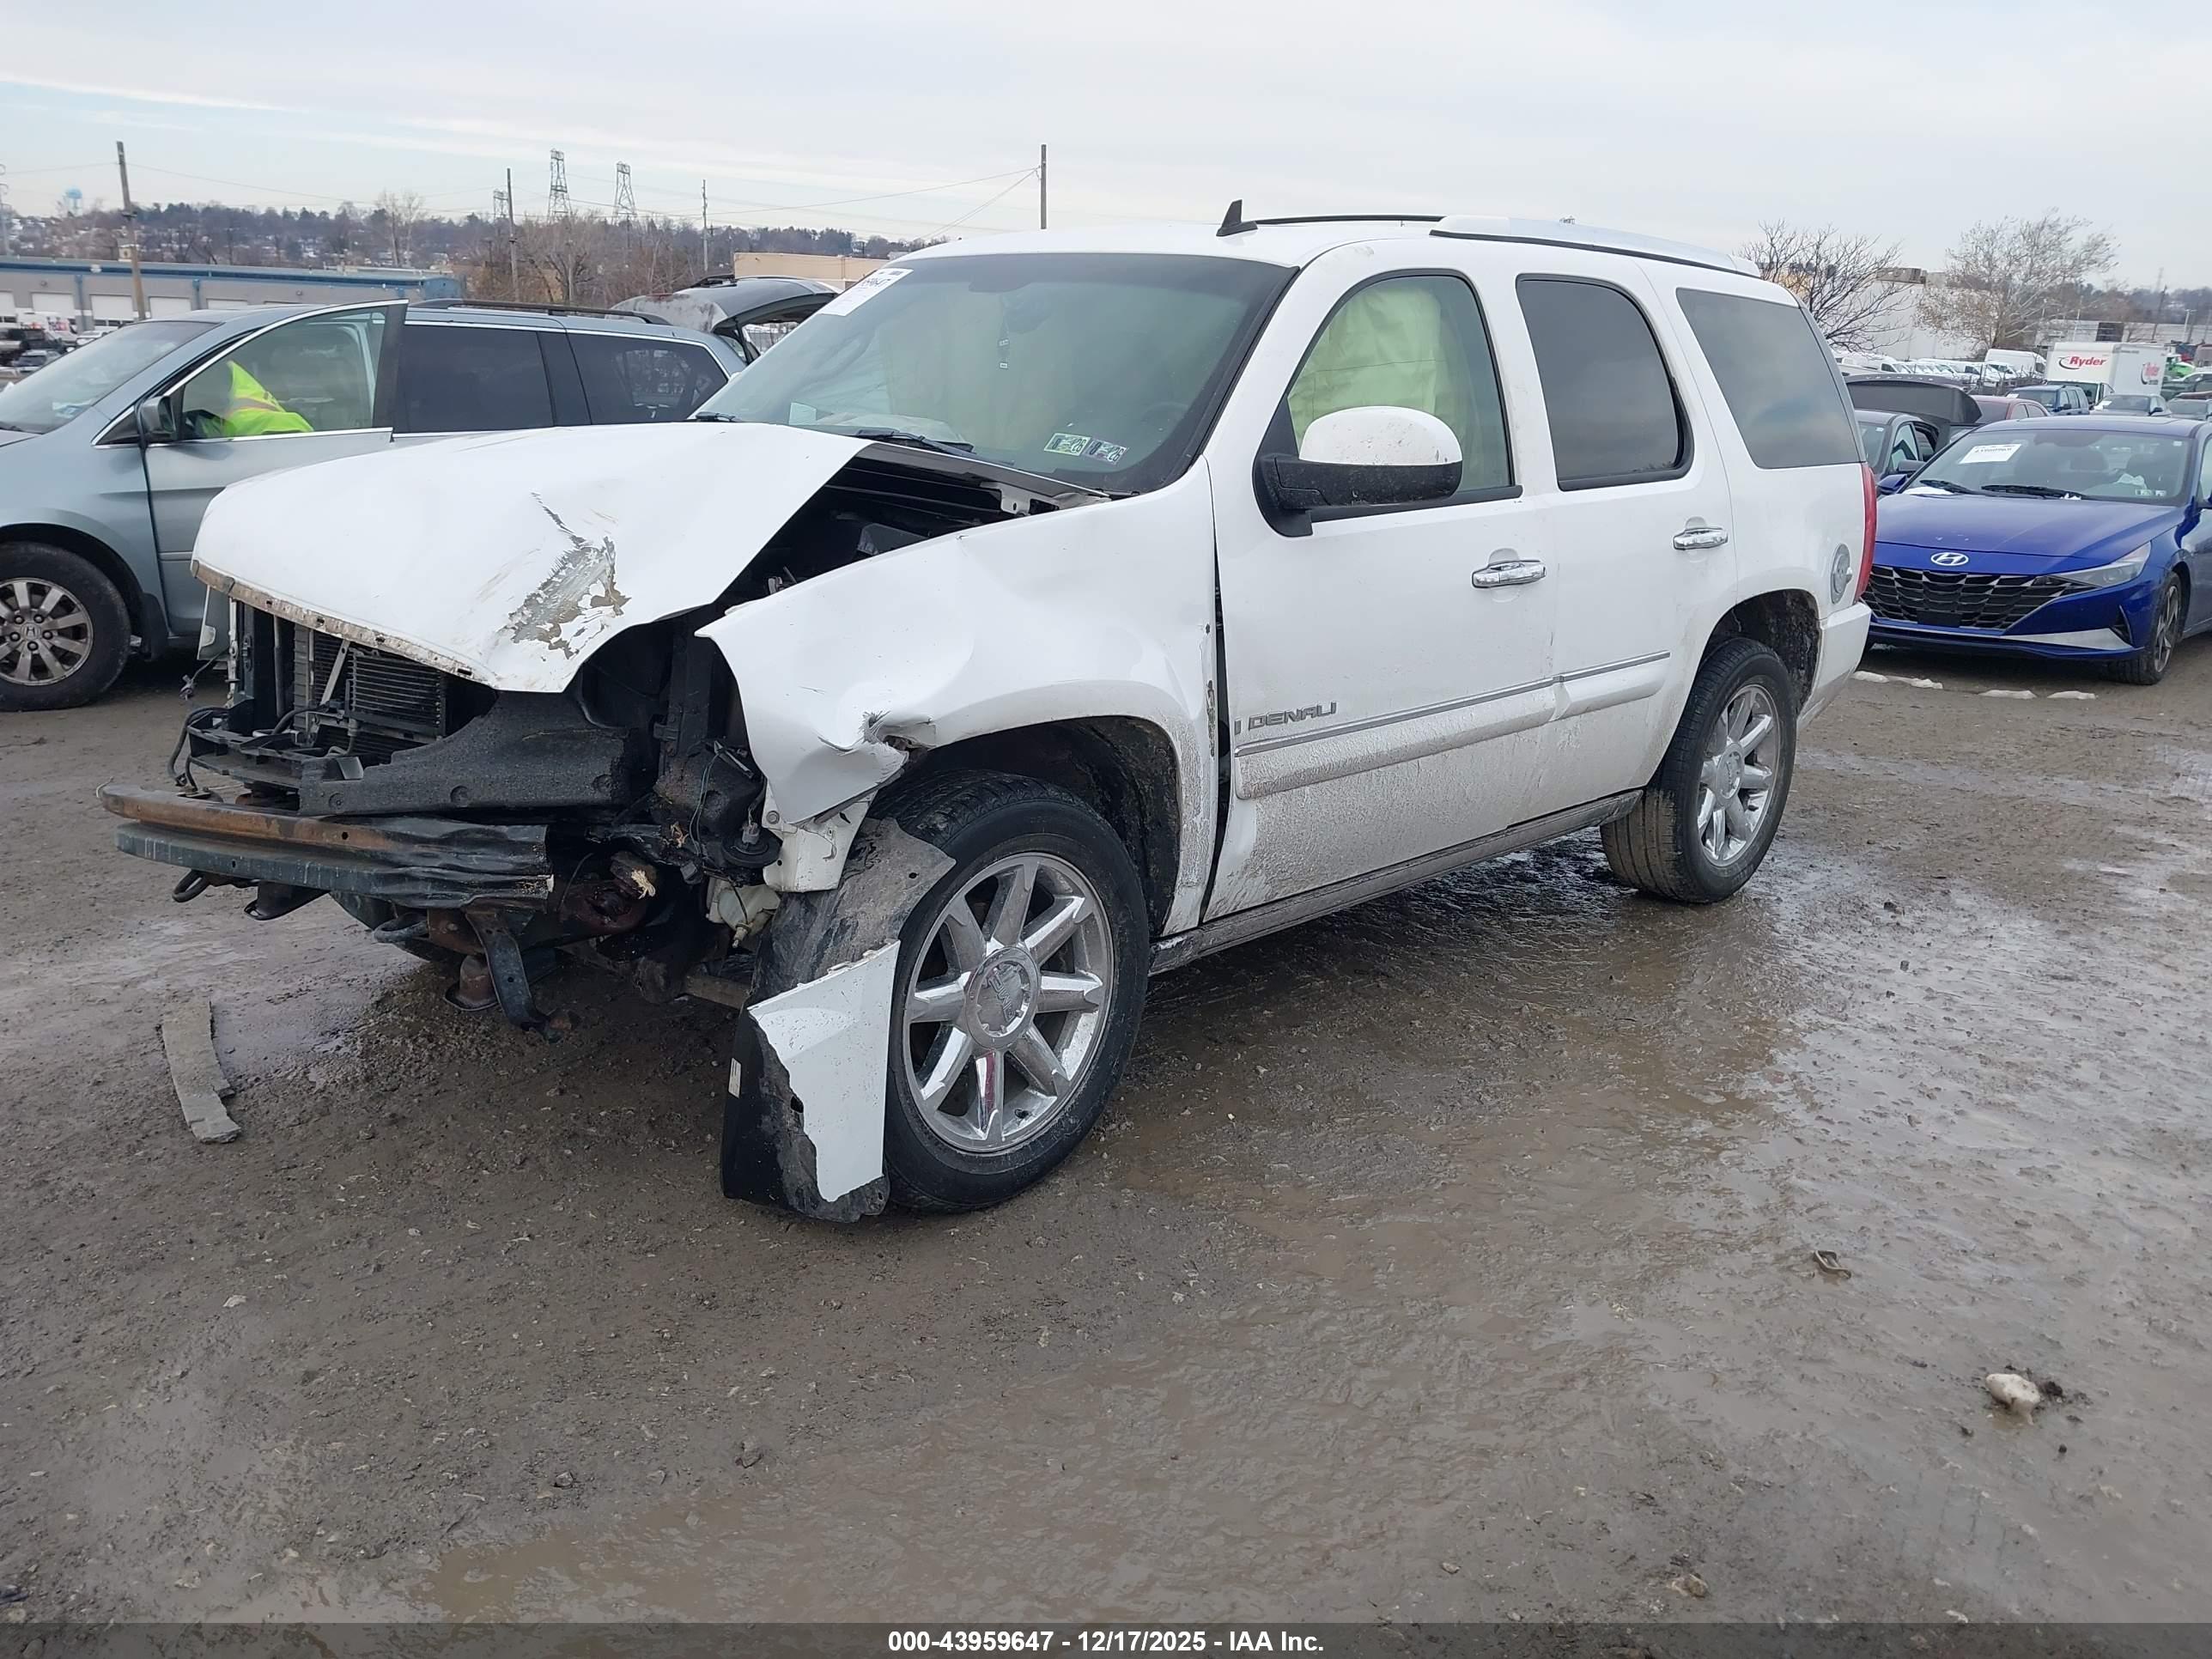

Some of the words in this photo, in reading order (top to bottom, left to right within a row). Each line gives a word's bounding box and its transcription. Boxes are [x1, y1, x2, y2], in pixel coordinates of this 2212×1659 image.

[2069, 356, 2106, 367] Ryder
[1248, 702, 1337, 731] DENALI
[988, 972, 1017, 1023] GMC
